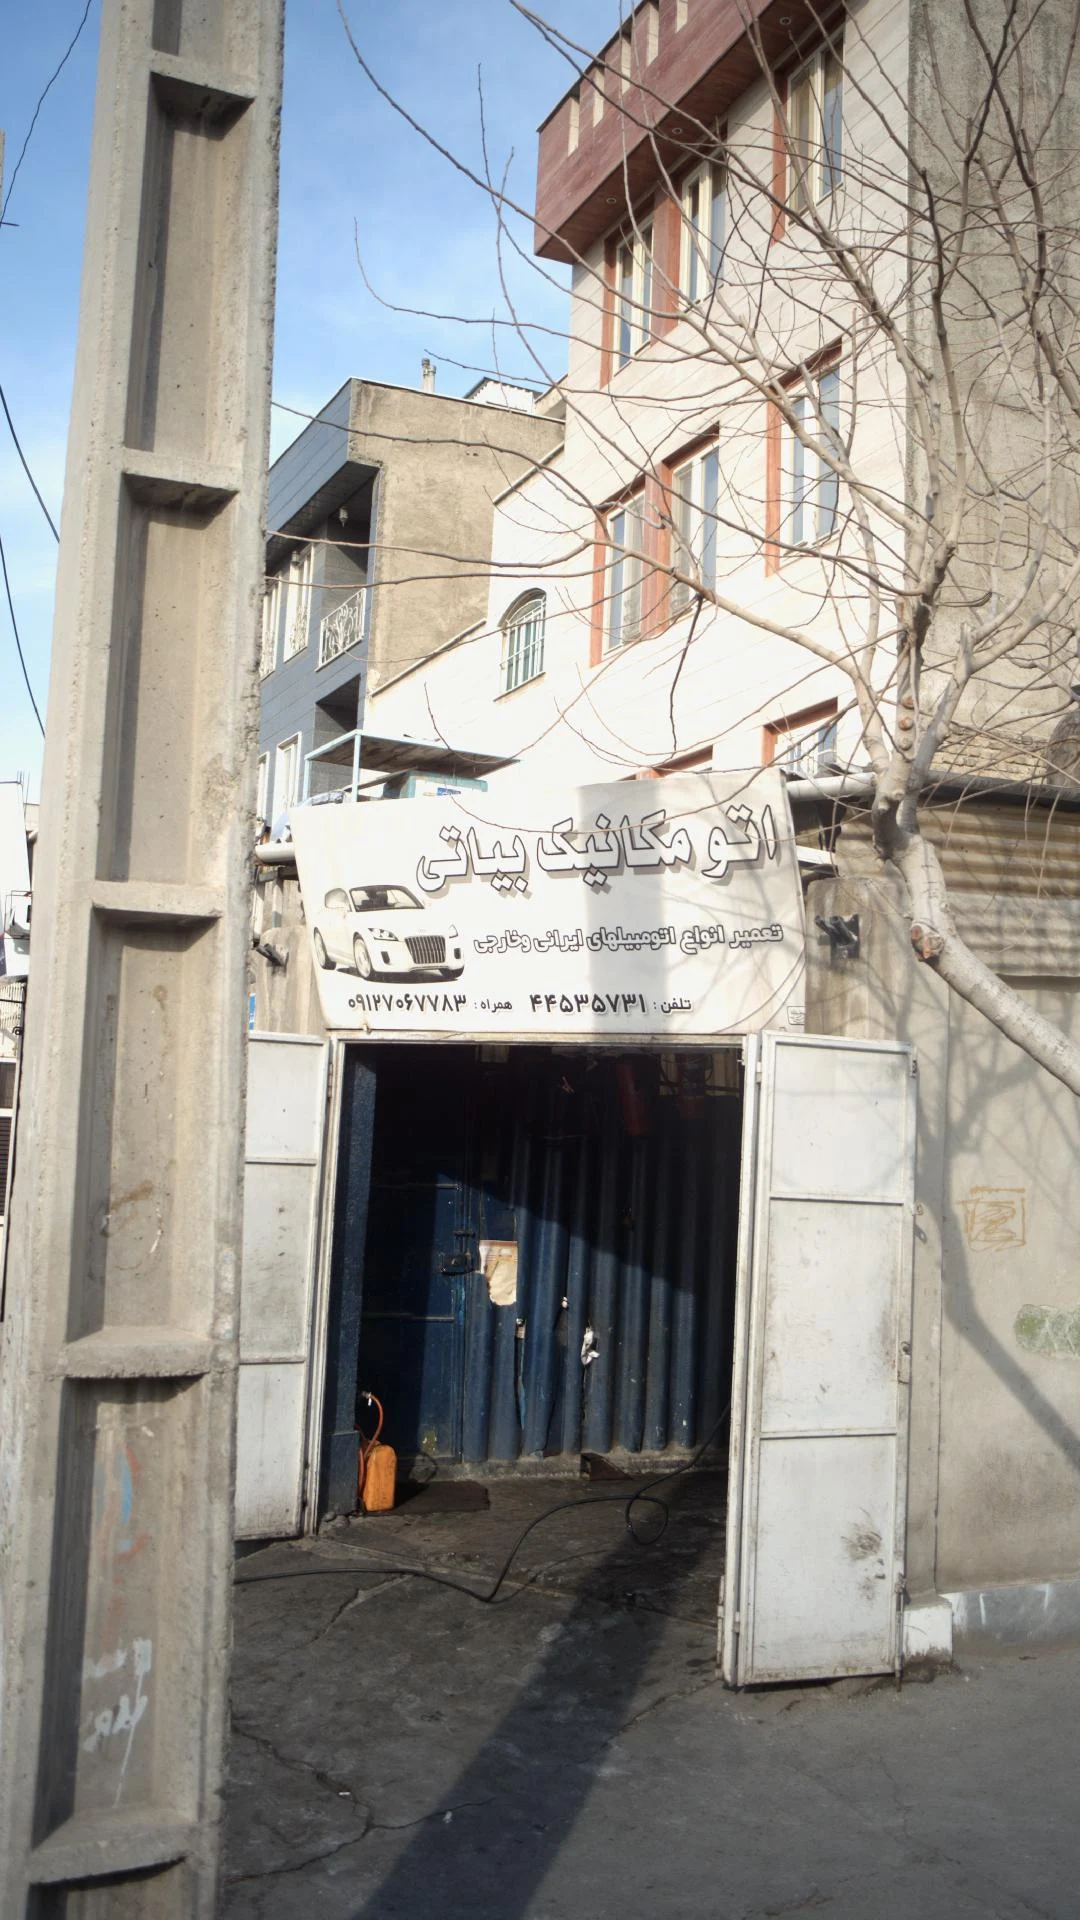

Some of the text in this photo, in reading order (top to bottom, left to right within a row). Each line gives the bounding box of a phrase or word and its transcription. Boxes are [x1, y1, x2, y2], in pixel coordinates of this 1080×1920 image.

[416, 804, 777, 893] اتو مکانیک بیاتی
[533, 929, 584, 952] ایرانی
[586, 926, 676, 952] اتومبیلهای
[680, 925, 725, 955] انواع
[729, 924, 783, 949] تعمیر
[348, 993, 467, 1012] ۰۹۱۲۷۰۶۷۷۸۳
[529, 994, 646, 1013] ۴۴۵۳۵۷۳۱
